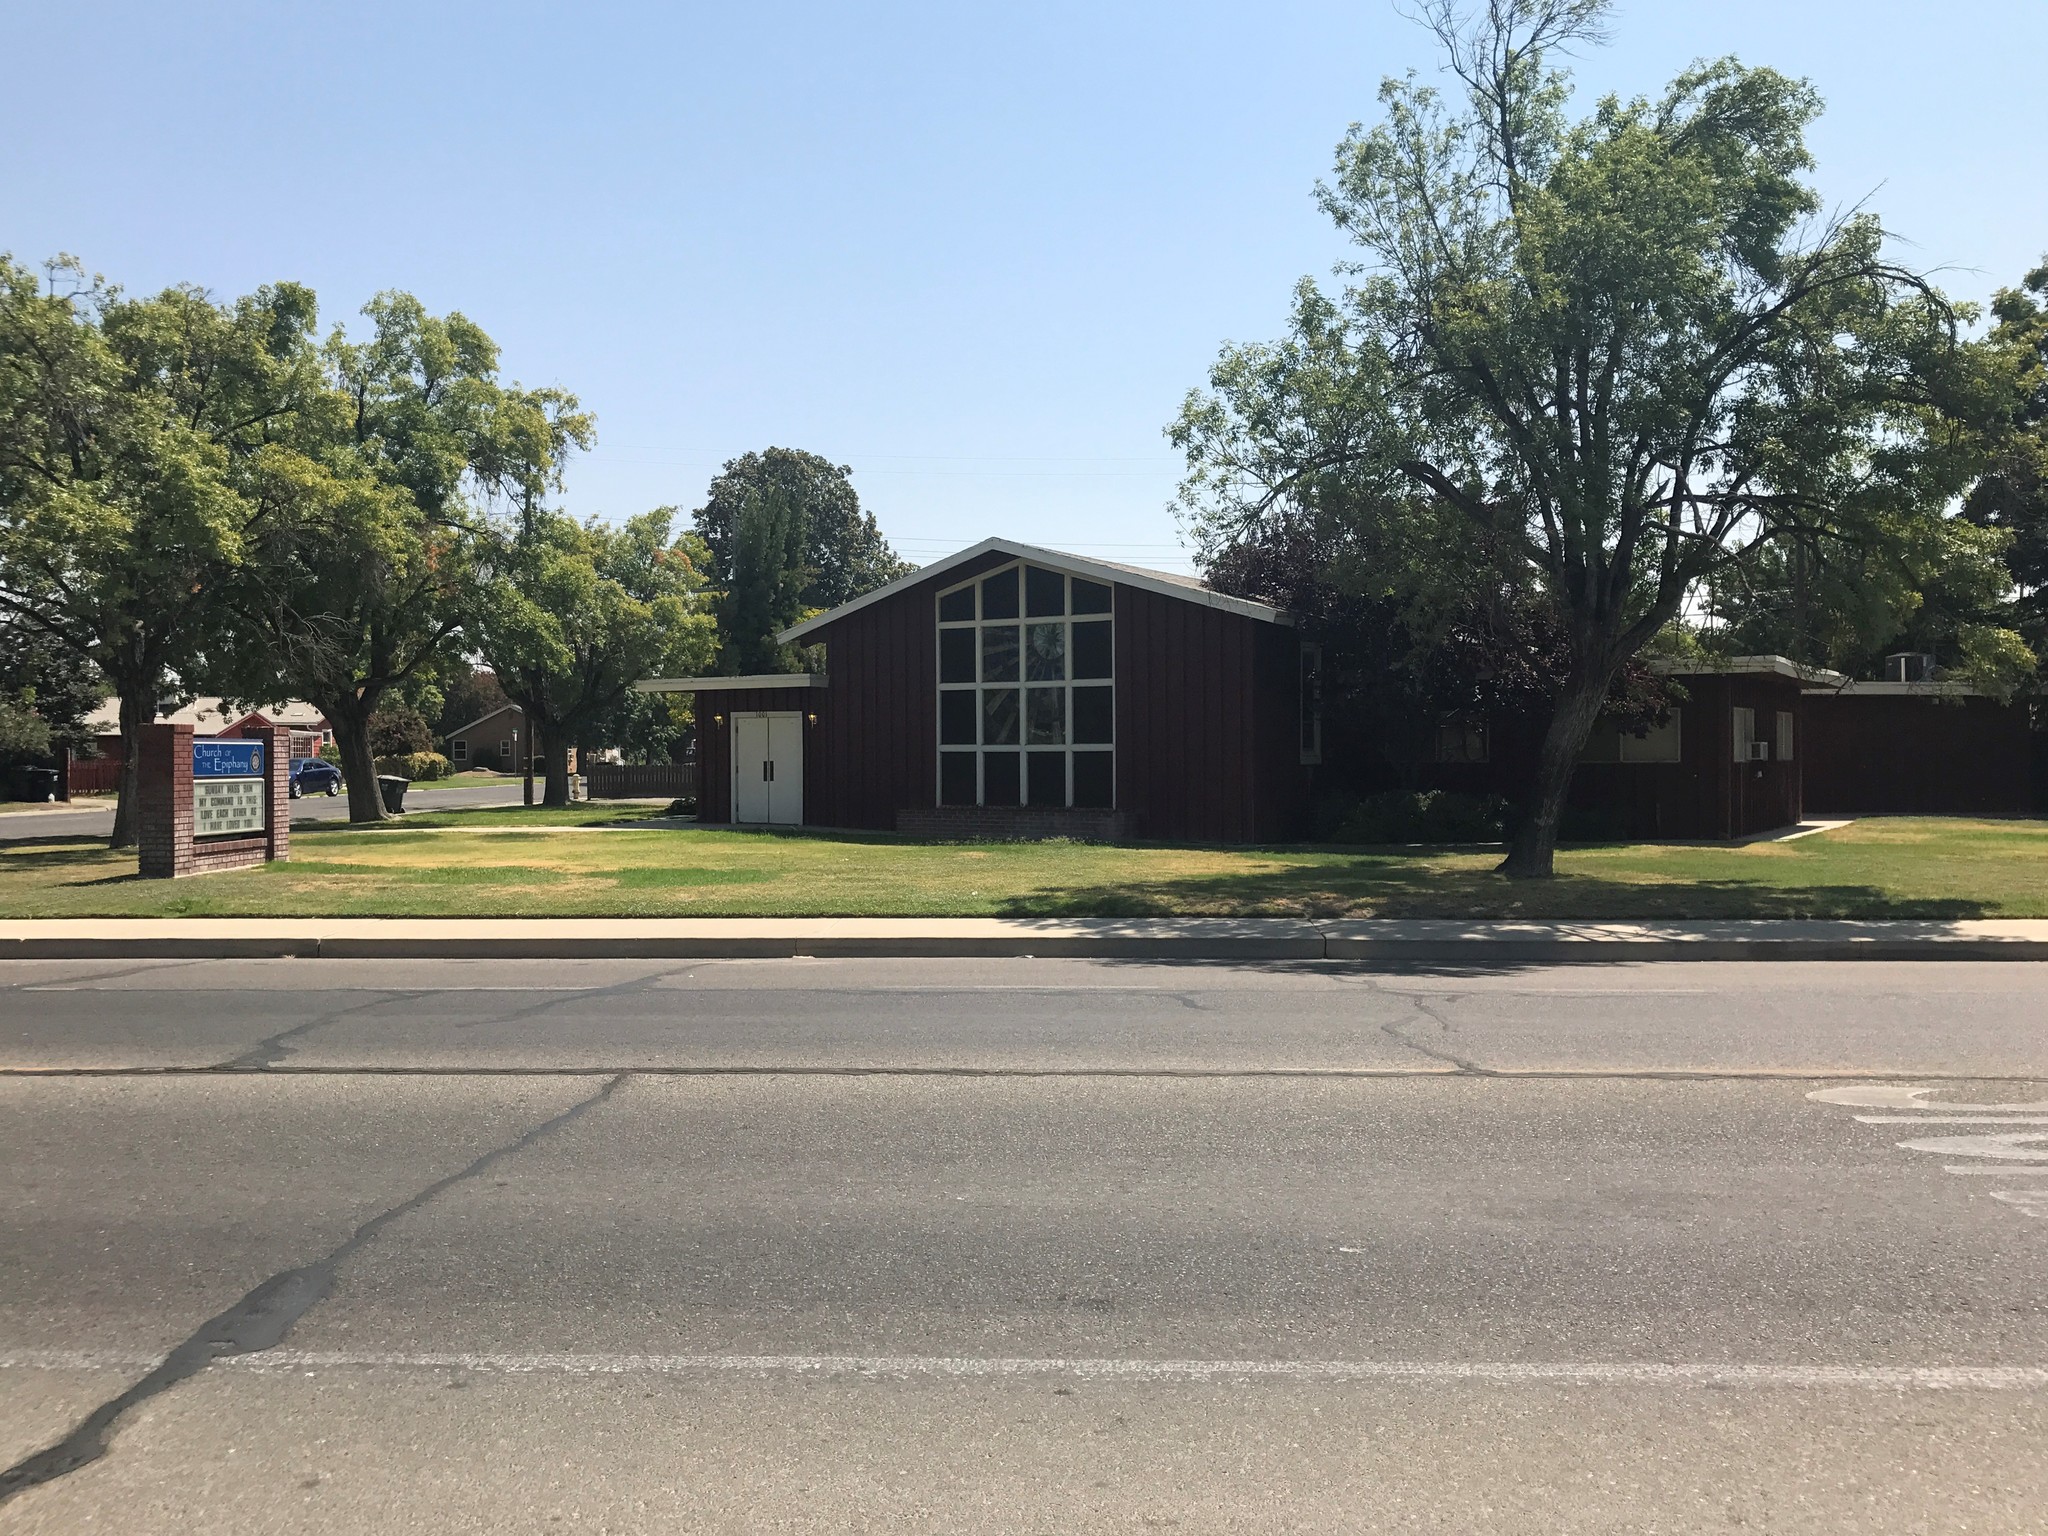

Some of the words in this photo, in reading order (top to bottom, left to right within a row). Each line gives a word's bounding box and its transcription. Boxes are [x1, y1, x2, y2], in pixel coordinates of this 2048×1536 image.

[194, 746, 222, 758] Church
[214, 756, 248, 774] Epiphany
[205, 785, 224, 794] SUNDAY
[227, 784, 240, 794] MASS
[199, 798, 206, 807] MY
[211, 797, 234, 806] COMMAND
[238, 796, 243, 805] IS
[246, 796, 256, 804] THIS
[201, 810, 212, 820] LOVE
[216, 809, 228, 818] EACH
[233, 808, 246, 817] OTHER
[250, 807, 256, 816] AS
[210, 820, 222, 830] HAVE
[226, 820, 240, 829] LOVED
[244, 819, 253, 828] YOU
